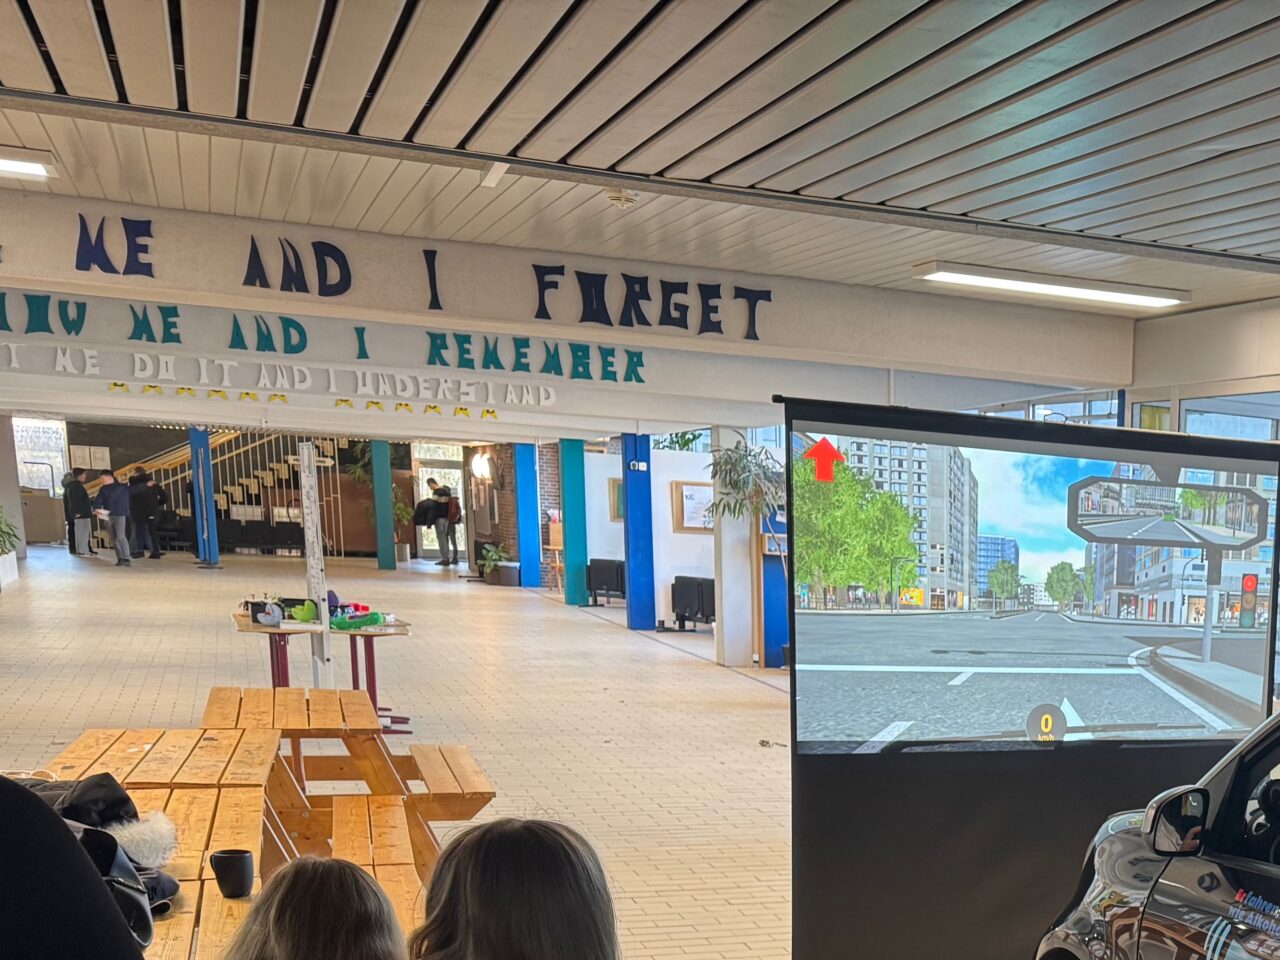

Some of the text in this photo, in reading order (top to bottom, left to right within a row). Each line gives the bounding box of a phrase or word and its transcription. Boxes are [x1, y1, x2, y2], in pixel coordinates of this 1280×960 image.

[75, 212, 772, 340] ME AND I FORGET
[55, 345, 101, 375] ME
[132, 352, 176, 381] DO
[199, 357, 239, 387] IT
[257, 363, 312, 391] AND
[327, 366, 339, 393] I
[355, 369, 556, 407] UNDERSTAND
[128, 304, 182, 344] ME
[228, 313, 308, 354] AND
[353, 326, 370, 360] I
[425, 331, 646, 383] REMEMBER
[1041, 713, 1052, 733] 0
